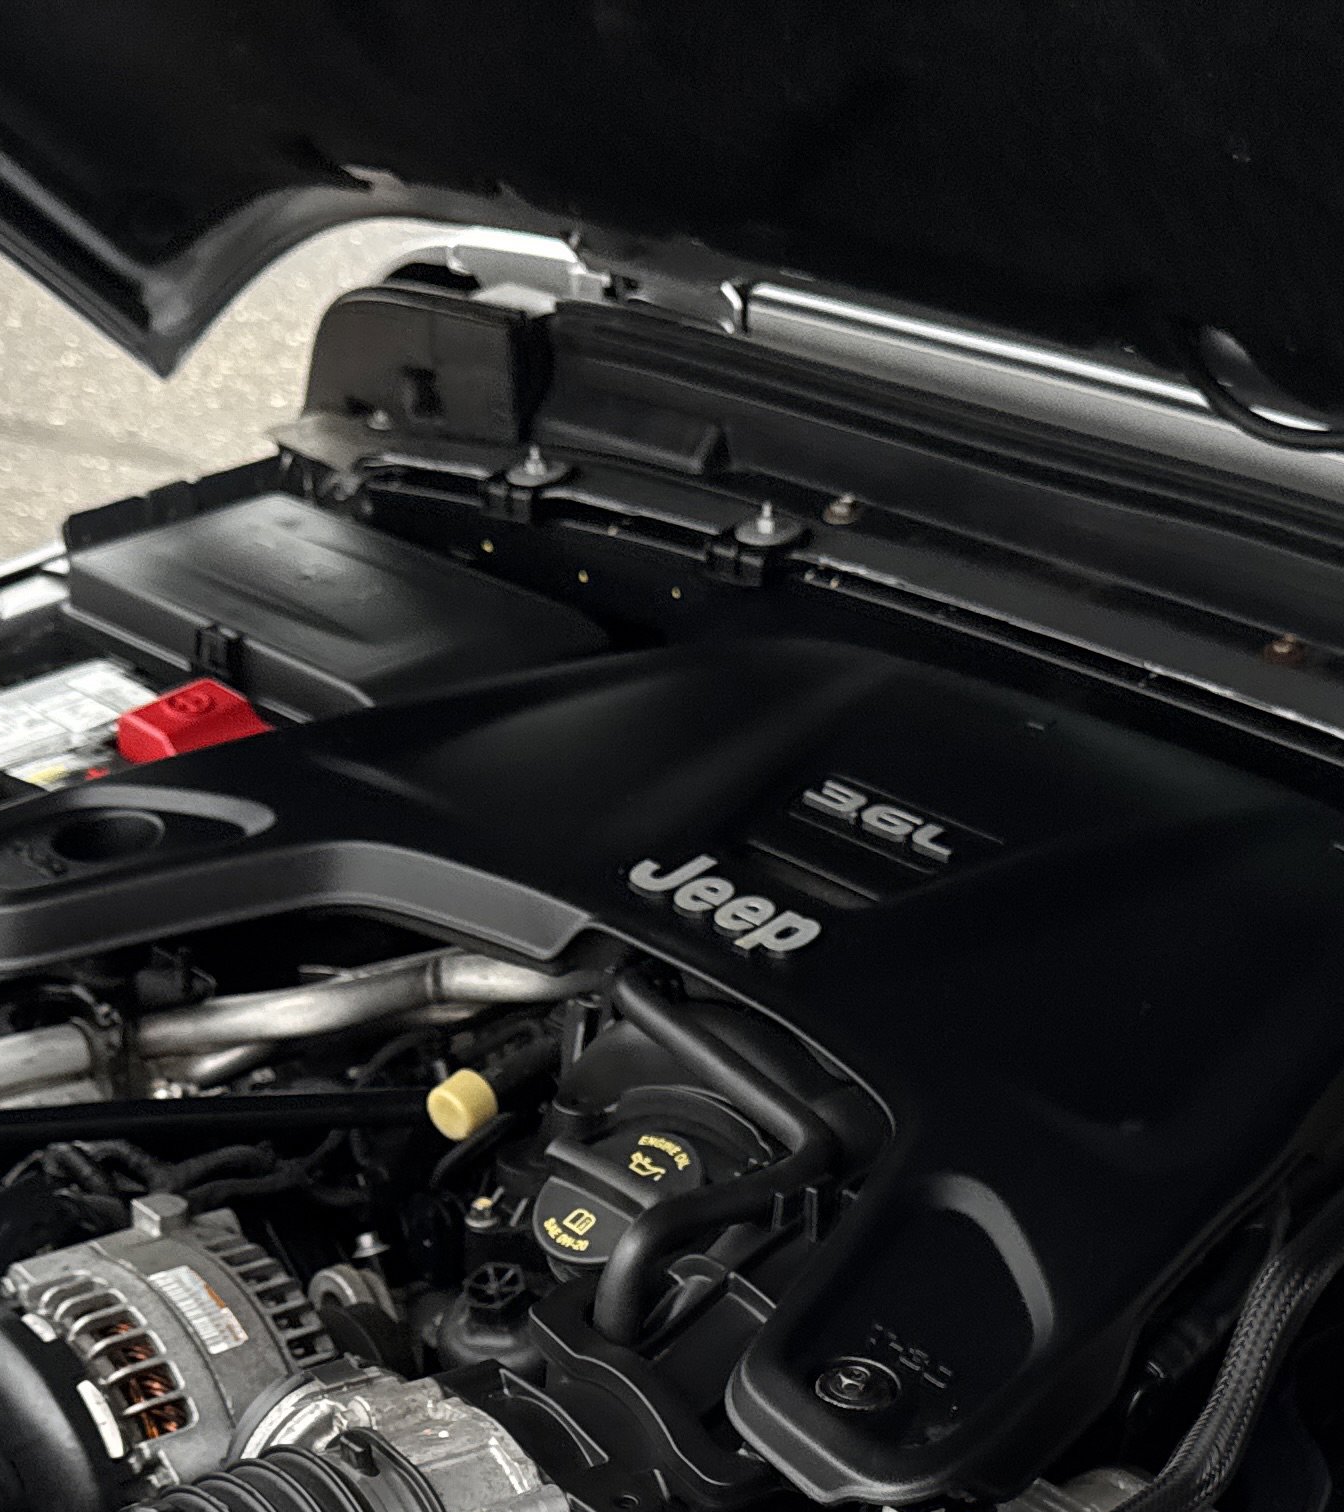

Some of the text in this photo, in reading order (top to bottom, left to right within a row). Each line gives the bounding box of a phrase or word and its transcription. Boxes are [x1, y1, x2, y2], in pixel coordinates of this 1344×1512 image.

[802, 780, 953, 863] 3.6L
[628, 855, 822, 953] Jeep
[638, 1134, 691, 1171] ENGINE OIL
[543, 1217, 562, 1239] SAE
